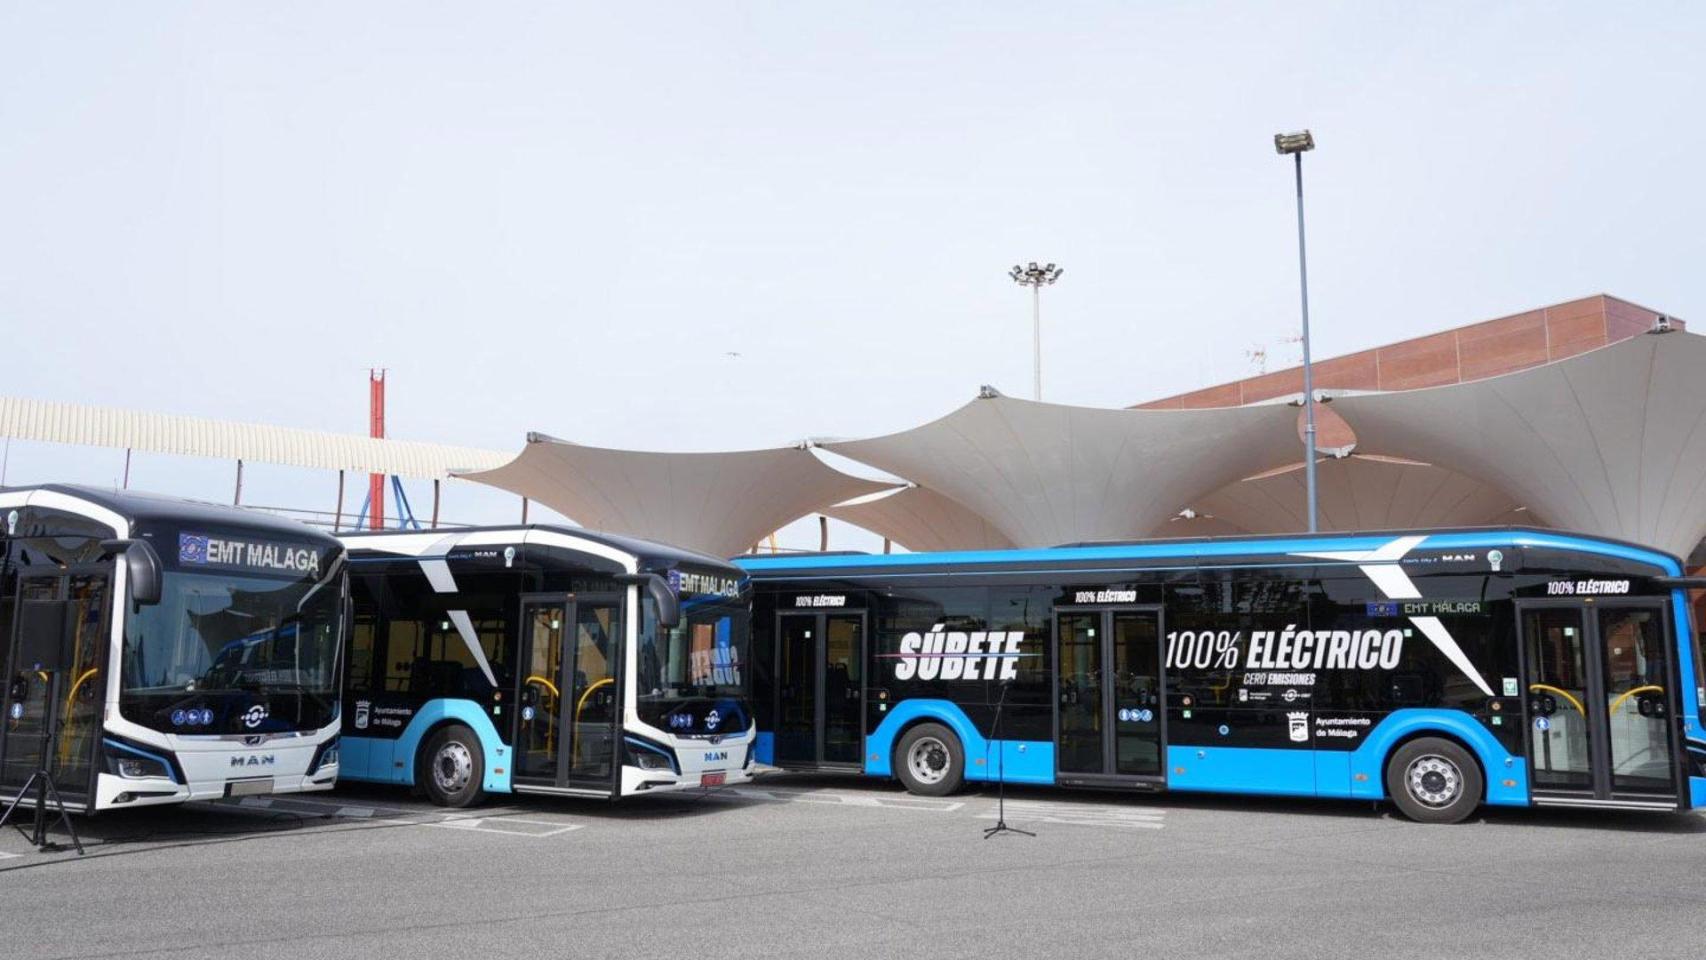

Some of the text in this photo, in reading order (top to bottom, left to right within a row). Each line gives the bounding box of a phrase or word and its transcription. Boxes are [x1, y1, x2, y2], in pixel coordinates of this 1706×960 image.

[207, 538, 245, 565] EMT
[1442, 554, 1476, 562] MAN
[680, 572, 700, 593] EMT
[1547, 578, 1630, 595] 100% ELÉCTRICO
[795, 594, 846, 607] 100% ELÉCTRICO
[1075, 588, 1137, 603] 100% ELÉCTRICO
[1404, 603, 1428, 613] EMT
[895, 623, 1025, 681] SÚBETE
[1165, 624, 1404, 670] 100% ELÉCTRICO
[1243, 672, 1317, 686] CERO EMISIONES
[1315, 717, 1371, 727] Ayuntamiento
[1327, 729, 1358, 739] Málaga
[230, 754, 275, 767] MAN
[704, 751, 728, 761] MAN
